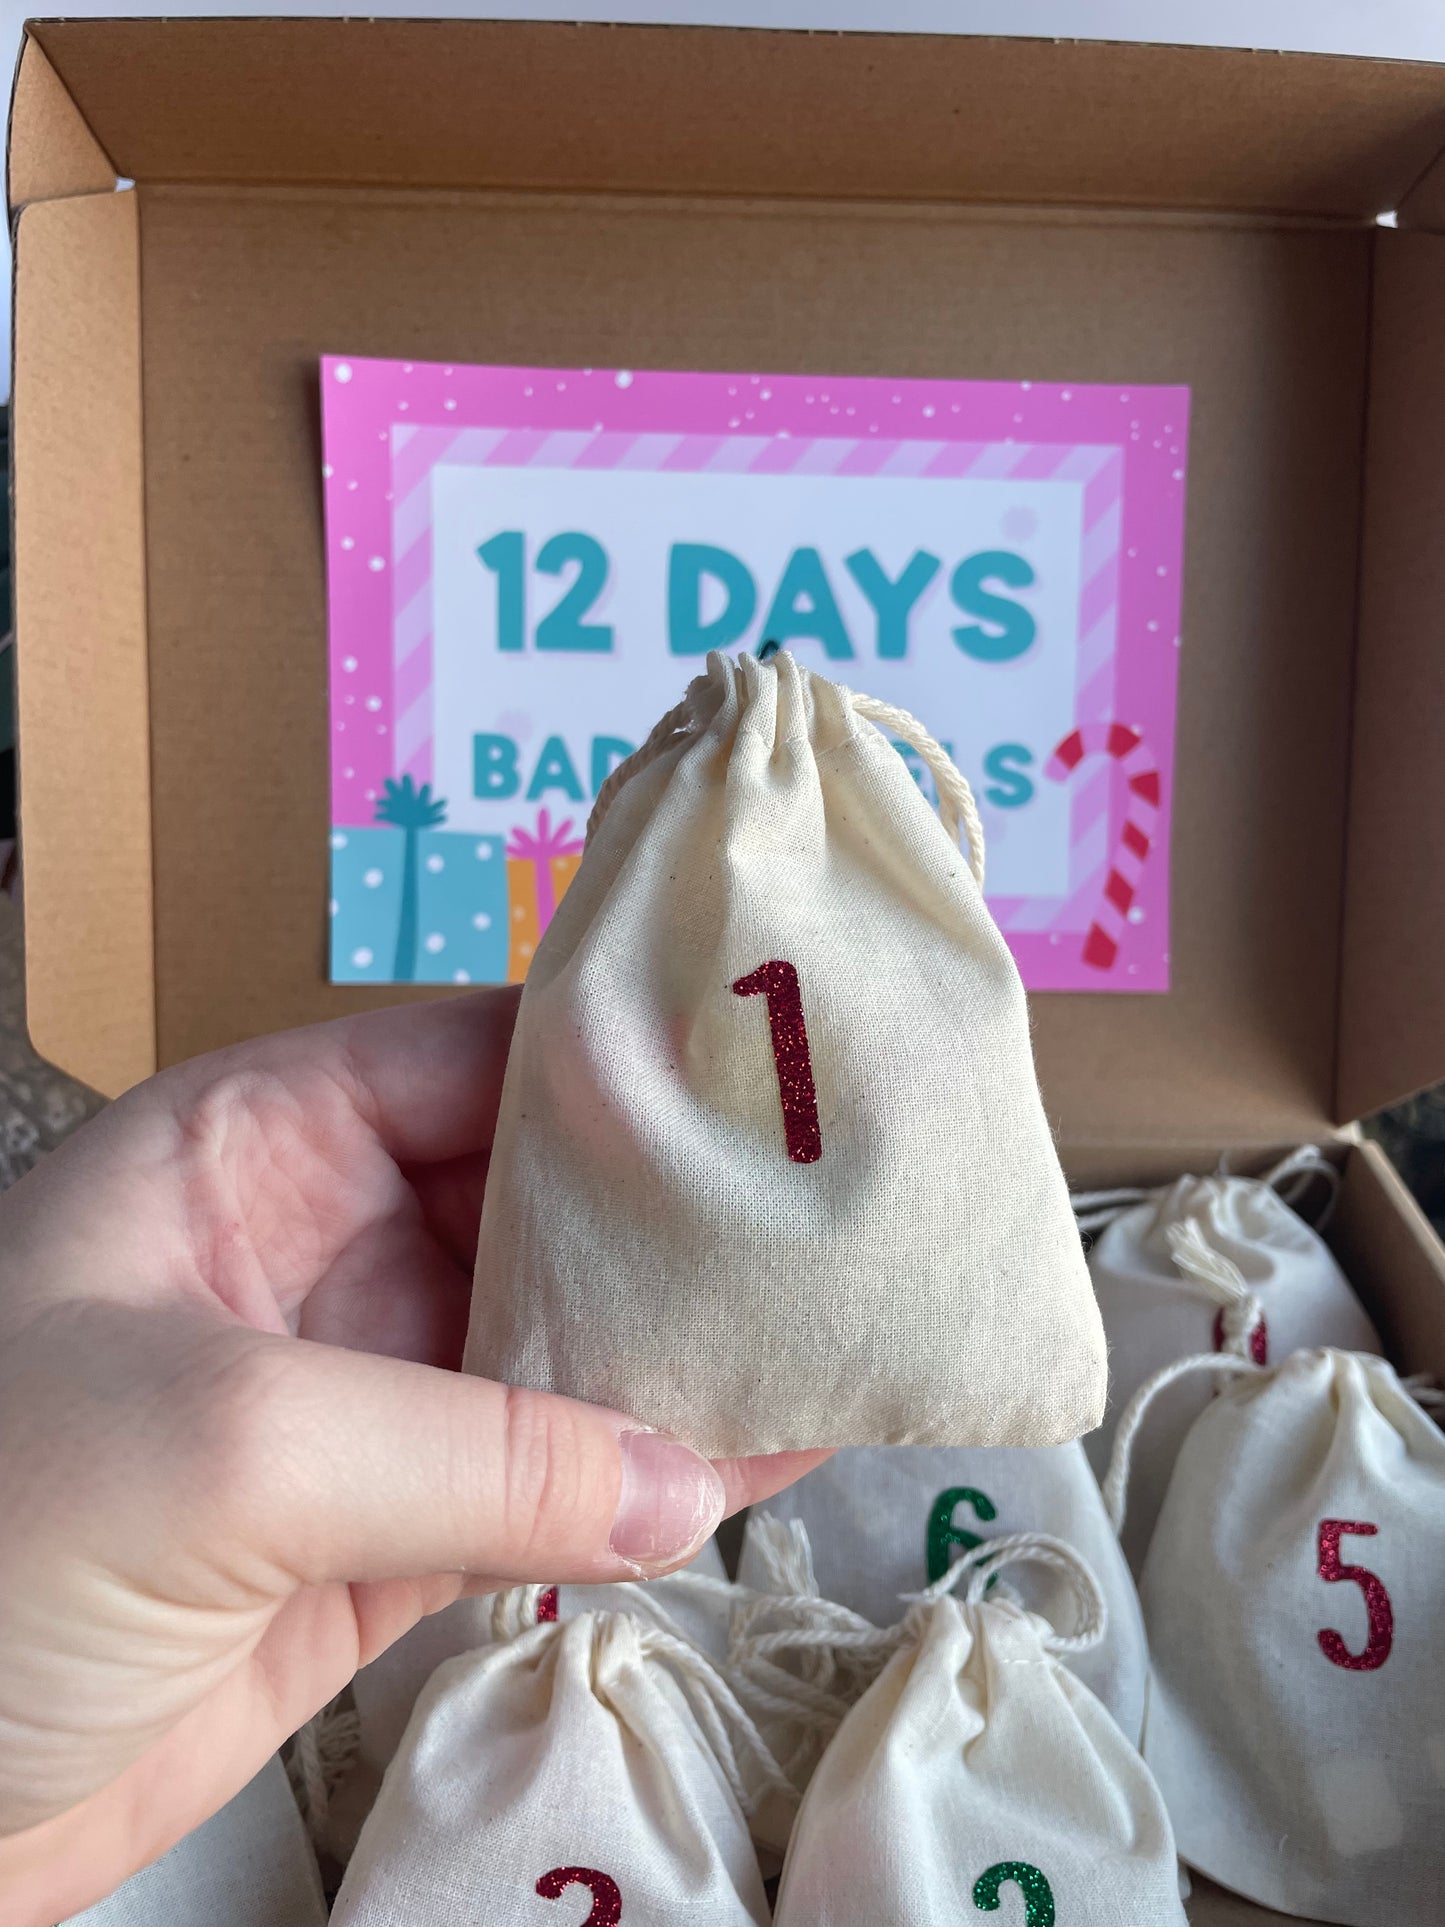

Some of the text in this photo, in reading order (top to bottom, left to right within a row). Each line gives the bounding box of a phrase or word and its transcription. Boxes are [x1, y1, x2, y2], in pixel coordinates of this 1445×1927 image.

[477, 531, 1037, 663] 12 DAYS
[733, 960, 822, 1164] 1
[1317, 1519, 1394, 1671] 5
